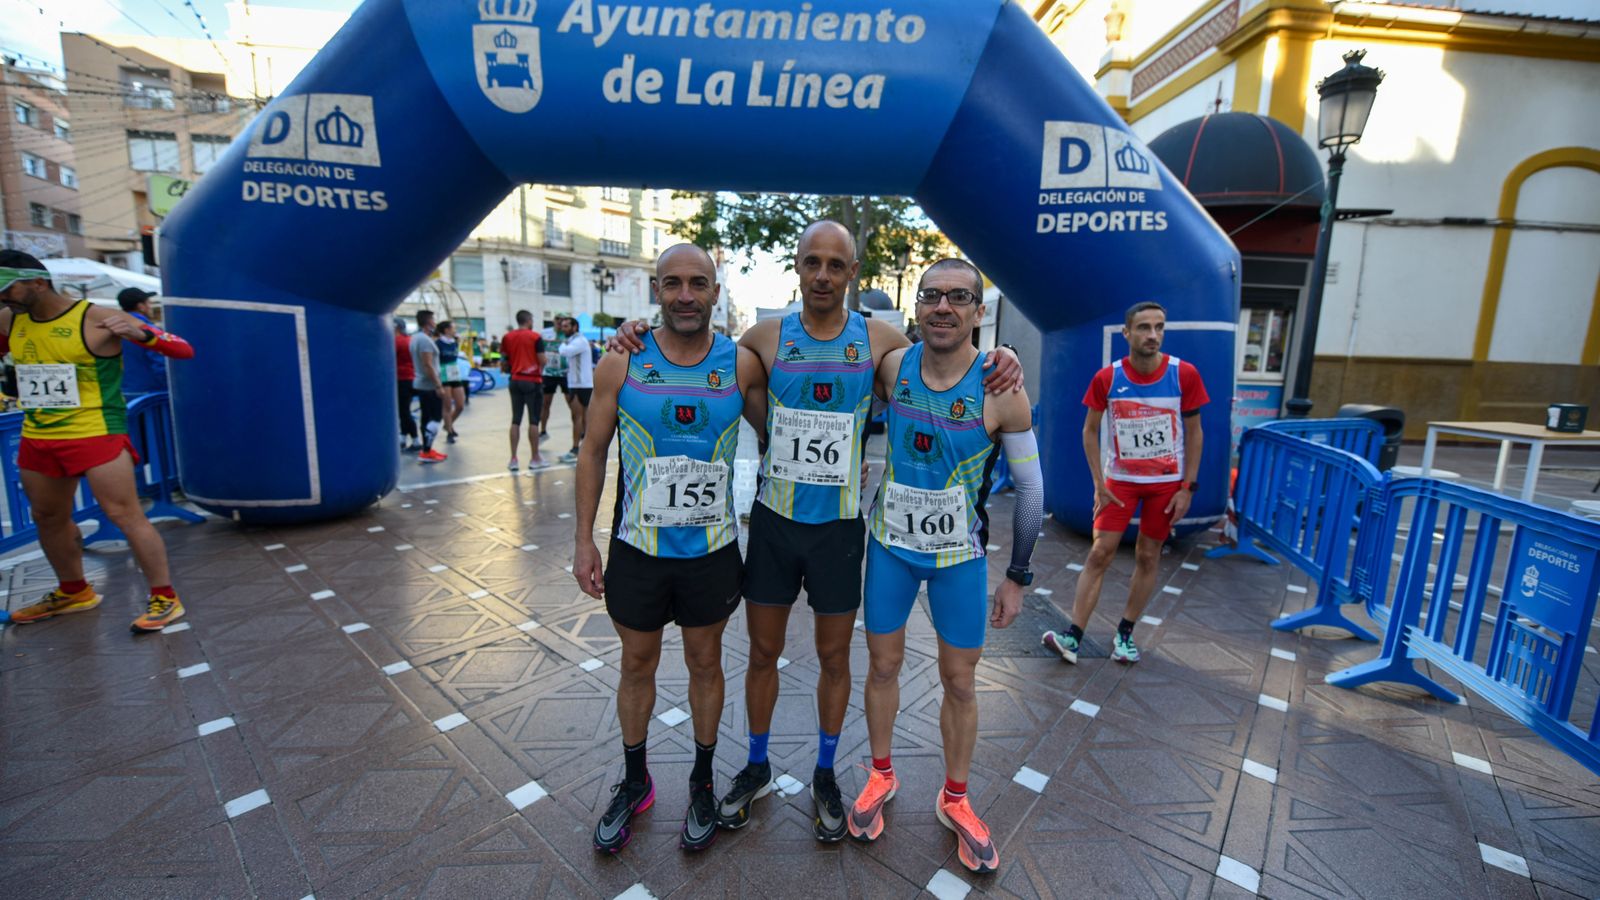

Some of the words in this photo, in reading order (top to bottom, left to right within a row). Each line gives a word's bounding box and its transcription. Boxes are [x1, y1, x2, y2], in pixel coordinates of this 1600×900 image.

[557, 0, 926, 48] Ayuntamiento
[602, 54, 663, 103] de
[675, 58, 736, 106] La
[746, 60, 886, 109] Línea
[262, 110, 291, 145] D
[1058, 136, 1091, 175] D
[243, 161, 330, 179] DELEGACIÓN
[334, 167, 356, 181] DE
[241, 180, 389, 211] DEPORTES
[1038, 189, 1126, 205] DELEGACIÓN
[1129, 191, 1146, 203] DE
[1036, 211, 1168, 233] DEPORTES
[30, 380, 68, 396] 214
[791, 437, 840, 465] 156
[1133, 430, 1165, 448] 183
[666, 482, 717, 508] 155
[904, 513, 955, 535] 160
[1528, 547, 1581, 574] DEPORTES
